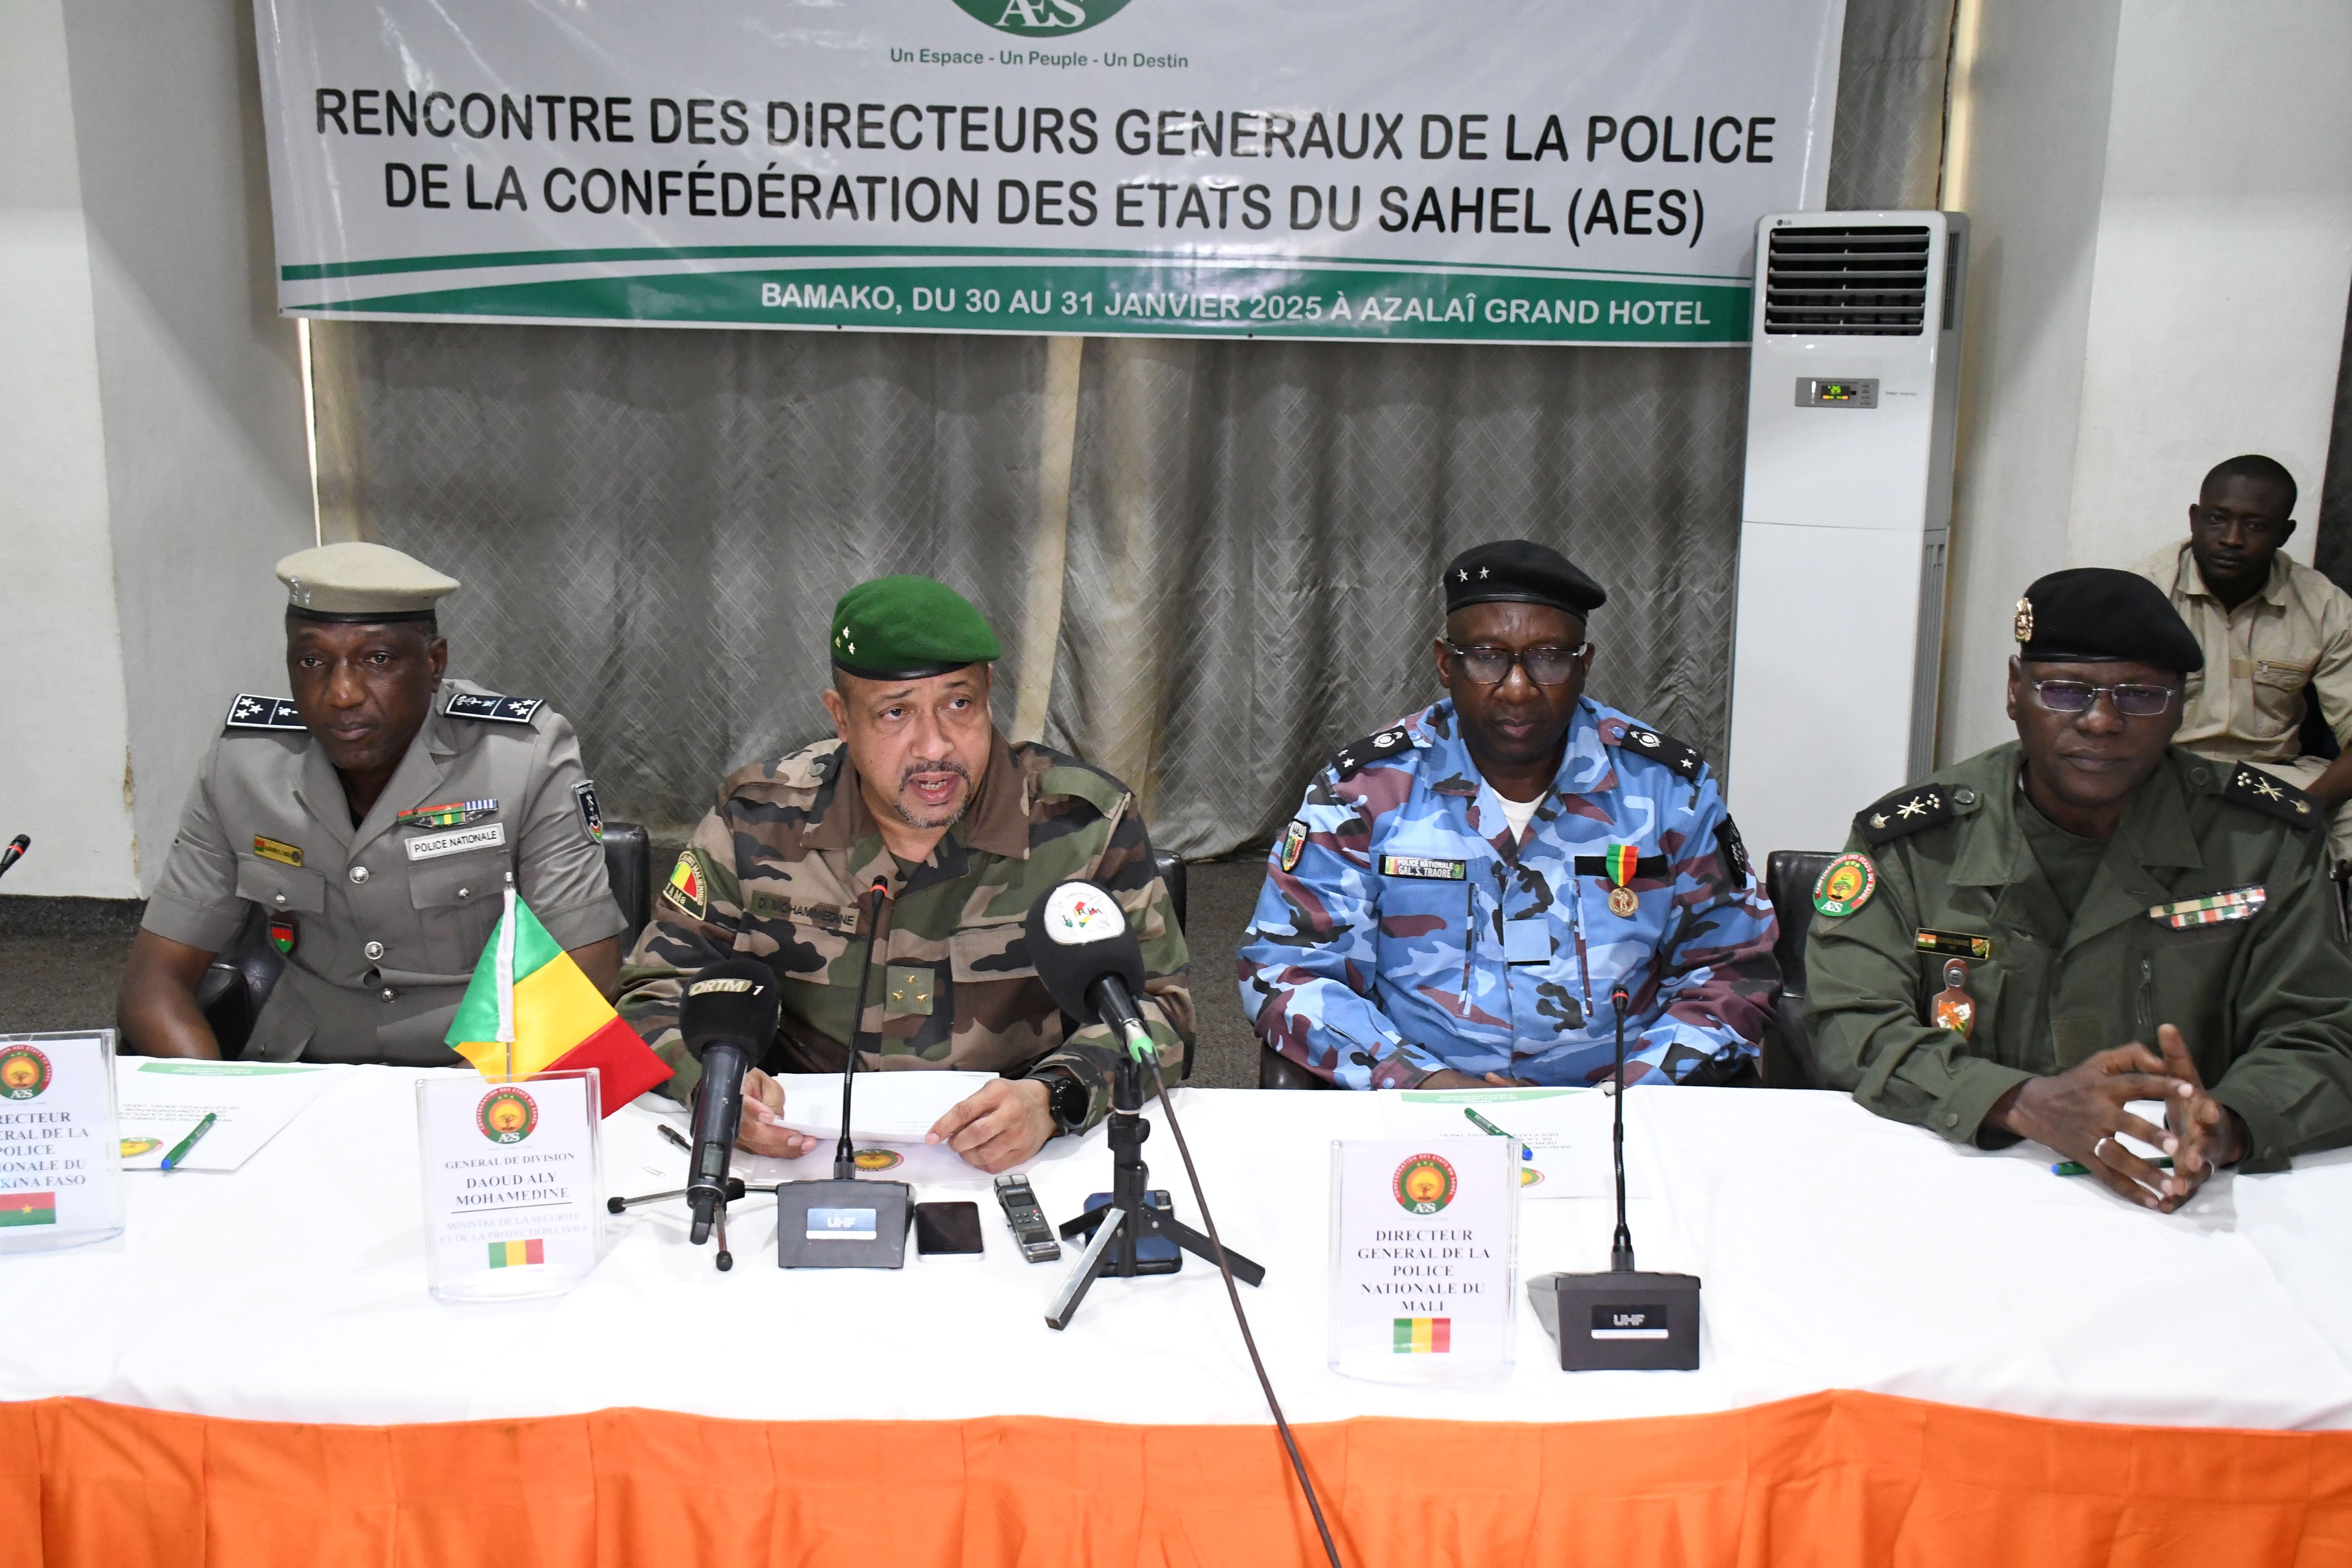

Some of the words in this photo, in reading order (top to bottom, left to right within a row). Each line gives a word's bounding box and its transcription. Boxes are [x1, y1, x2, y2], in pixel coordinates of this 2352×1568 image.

[890, 48, 914, 63] Un
[920, 49, 983, 66] Espace
[999, 50, 1023, 65] Un
[1029, 51, 1087, 69] Peuple
[1104, 52, 1127, 67] Un
[1133, 53, 1188, 68] Destin
[316, 88, 634, 142] RENCONTRE
[651, 98, 749, 146] DES
[768, 101, 1098, 155] DIRECTEURS
[1116, 109, 1404, 160] GENERAUX
[1420, 114, 1489, 160] DE
[1506, 114, 1568, 162] LA
[1587, 115, 1776, 163] POLICE
[385, 162, 450, 208] DE
[466, 164, 528, 211] LA
[544, 160, 978, 224] CONFÉDÉRATION
[998, 179, 1098, 226] DES
[1116, 182, 1271, 230] ETATS
[1290, 185, 1361, 232] DU
[1379, 186, 1551, 233] SAHEL
[1568, 187, 1704, 248] (AES)
[761, 283, 902, 315] BAMAKO,
[913, 288, 956, 313] DU
[965, 288, 1000, 314] 30
[1009, 290, 1052, 315] AU
[1061, 291, 1093, 316] 31
[1105, 291, 1240, 318] JANVIER
[1250, 294, 1322, 320] 2025
[1330, 290, 1352, 321] À
[1360, 293, 1475, 323] AZALAÎ
[1484, 297, 1599, 324] GRAND
[1609, 300, 1710, 325] HOTEL
[414, 839, 447, 853] POLICE
[449, 830, 497, 847] NATIONALE
[1398, 866, 1414, 875] GAL.
[1424, 867, 1451, 878] TRAORE
[1420, 860, 1453, 870] NATIONALE
[694, 980, 745, 994] ORTM
[753, 985, 764, 996] 1
[42, 1128, 63, 1139] DE
[68, 1127, 89, 1138] LA
[0, 1160, 59, 1173] ONALE
[64, 1159, 86, 1170] DU
[446, 1158, 502, 1169] GENERAL
[504, 1156, 520, 1165] DE
[523, 1152, 575, 1164] DIVISION
[45, 1174, 86, 1186] FASO
[466, 1174, 523, 1189] DAOUD
[526, 1171, 557, 1184] ALY
[455, 1187, 569, 1206] MOHAMEDINE
[447, 1219, 496, 1231] MINISTRE
[516, 1217, 529, 1225] LA
[531, 1212, 581, 1224] SECURITE
[827, 1217, 856, 1228] UHF
[472, 1233, 486, 1241] LA
[488, 1227, 553, 1239] PROTECTION
[555, 1224, 588, 1234] CIVILE
[1376, 1230, 1473, 1241] DIRECTEUR
[1358, 1248, 1438, 1259] GENERAL
[1443, 1248, 1464, 1258] DE
[1469, 1248, 1490, 1258] LA
[1393, 1266, 1454, 1277] POLICE
[1361, 1283, 1457, 1294] NATIONALE
[1463, 1283, 1485, 1293] DU
[1401, 1301, 1443, 1311] MALI
[1614, 1314, 1645, 1326] UHF
